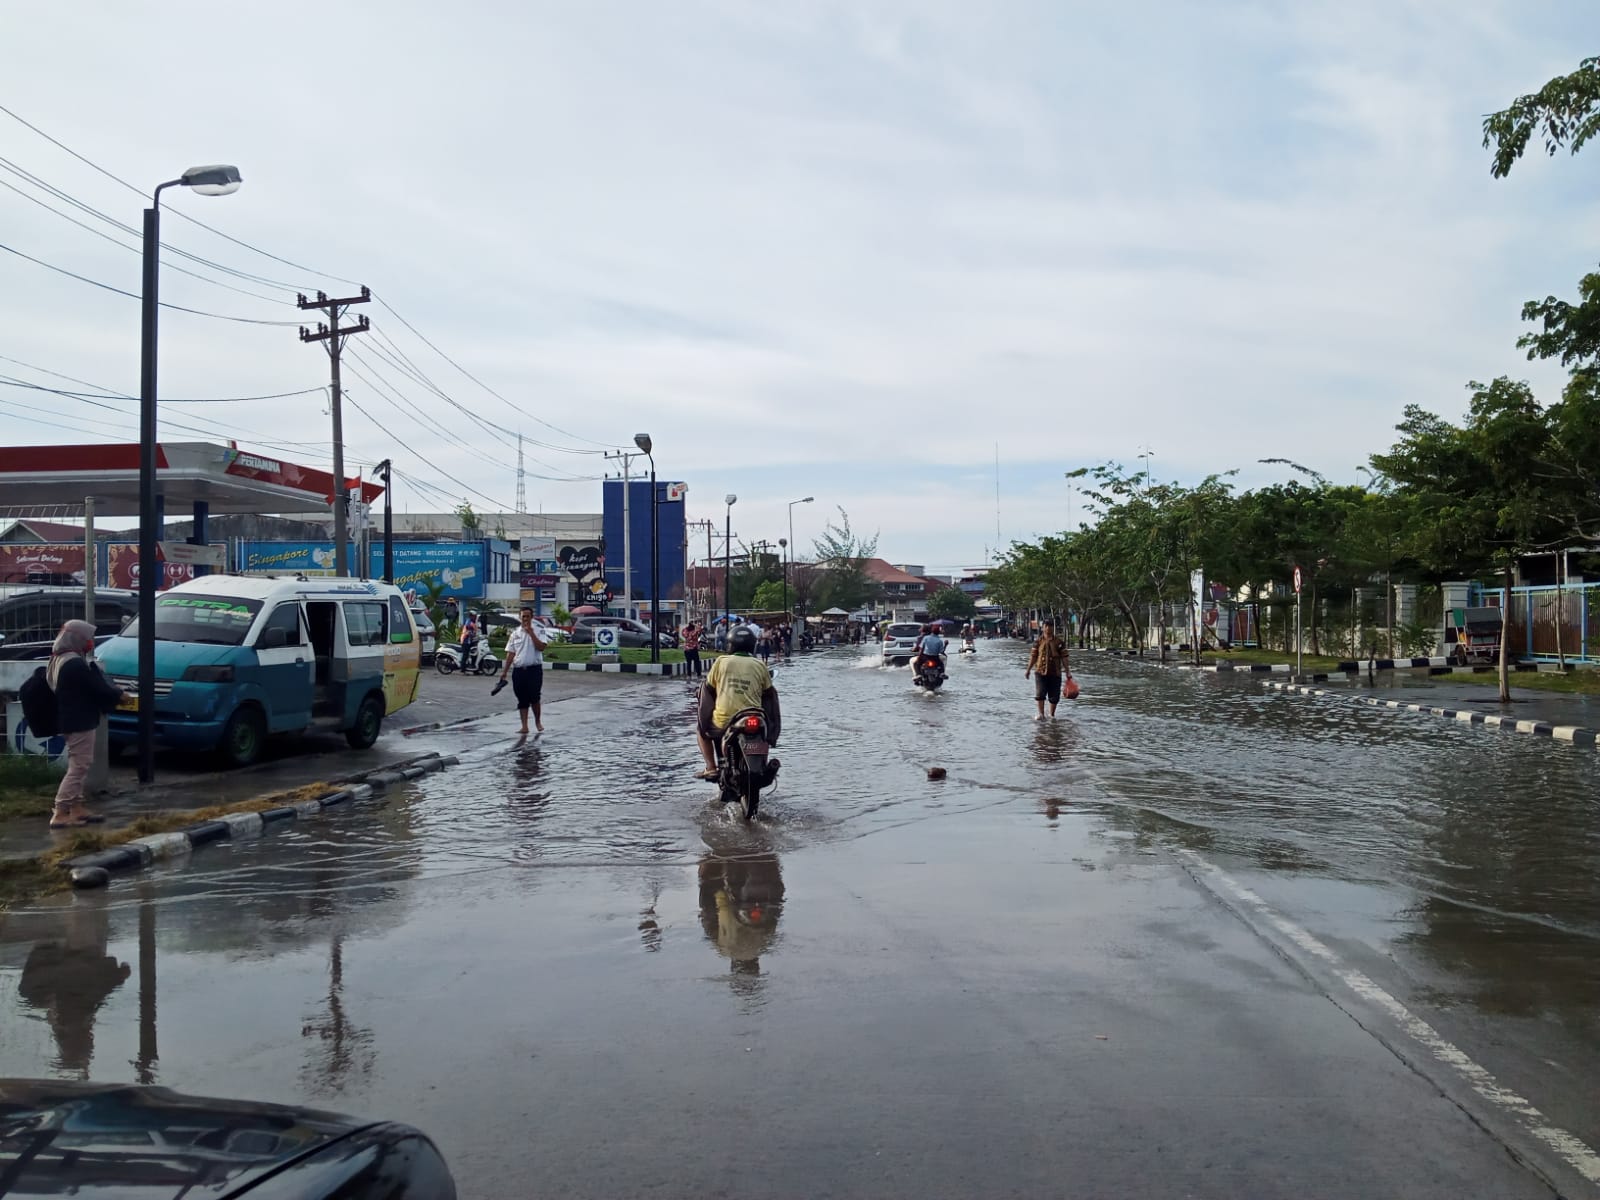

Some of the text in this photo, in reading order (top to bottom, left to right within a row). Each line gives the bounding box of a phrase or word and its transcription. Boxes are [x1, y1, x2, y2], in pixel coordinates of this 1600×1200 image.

[241, 454, 281, 473] PERTAMINA
[248, 548, 308, 568] Singapore
[160, 599, 249, 613] PUTRA
